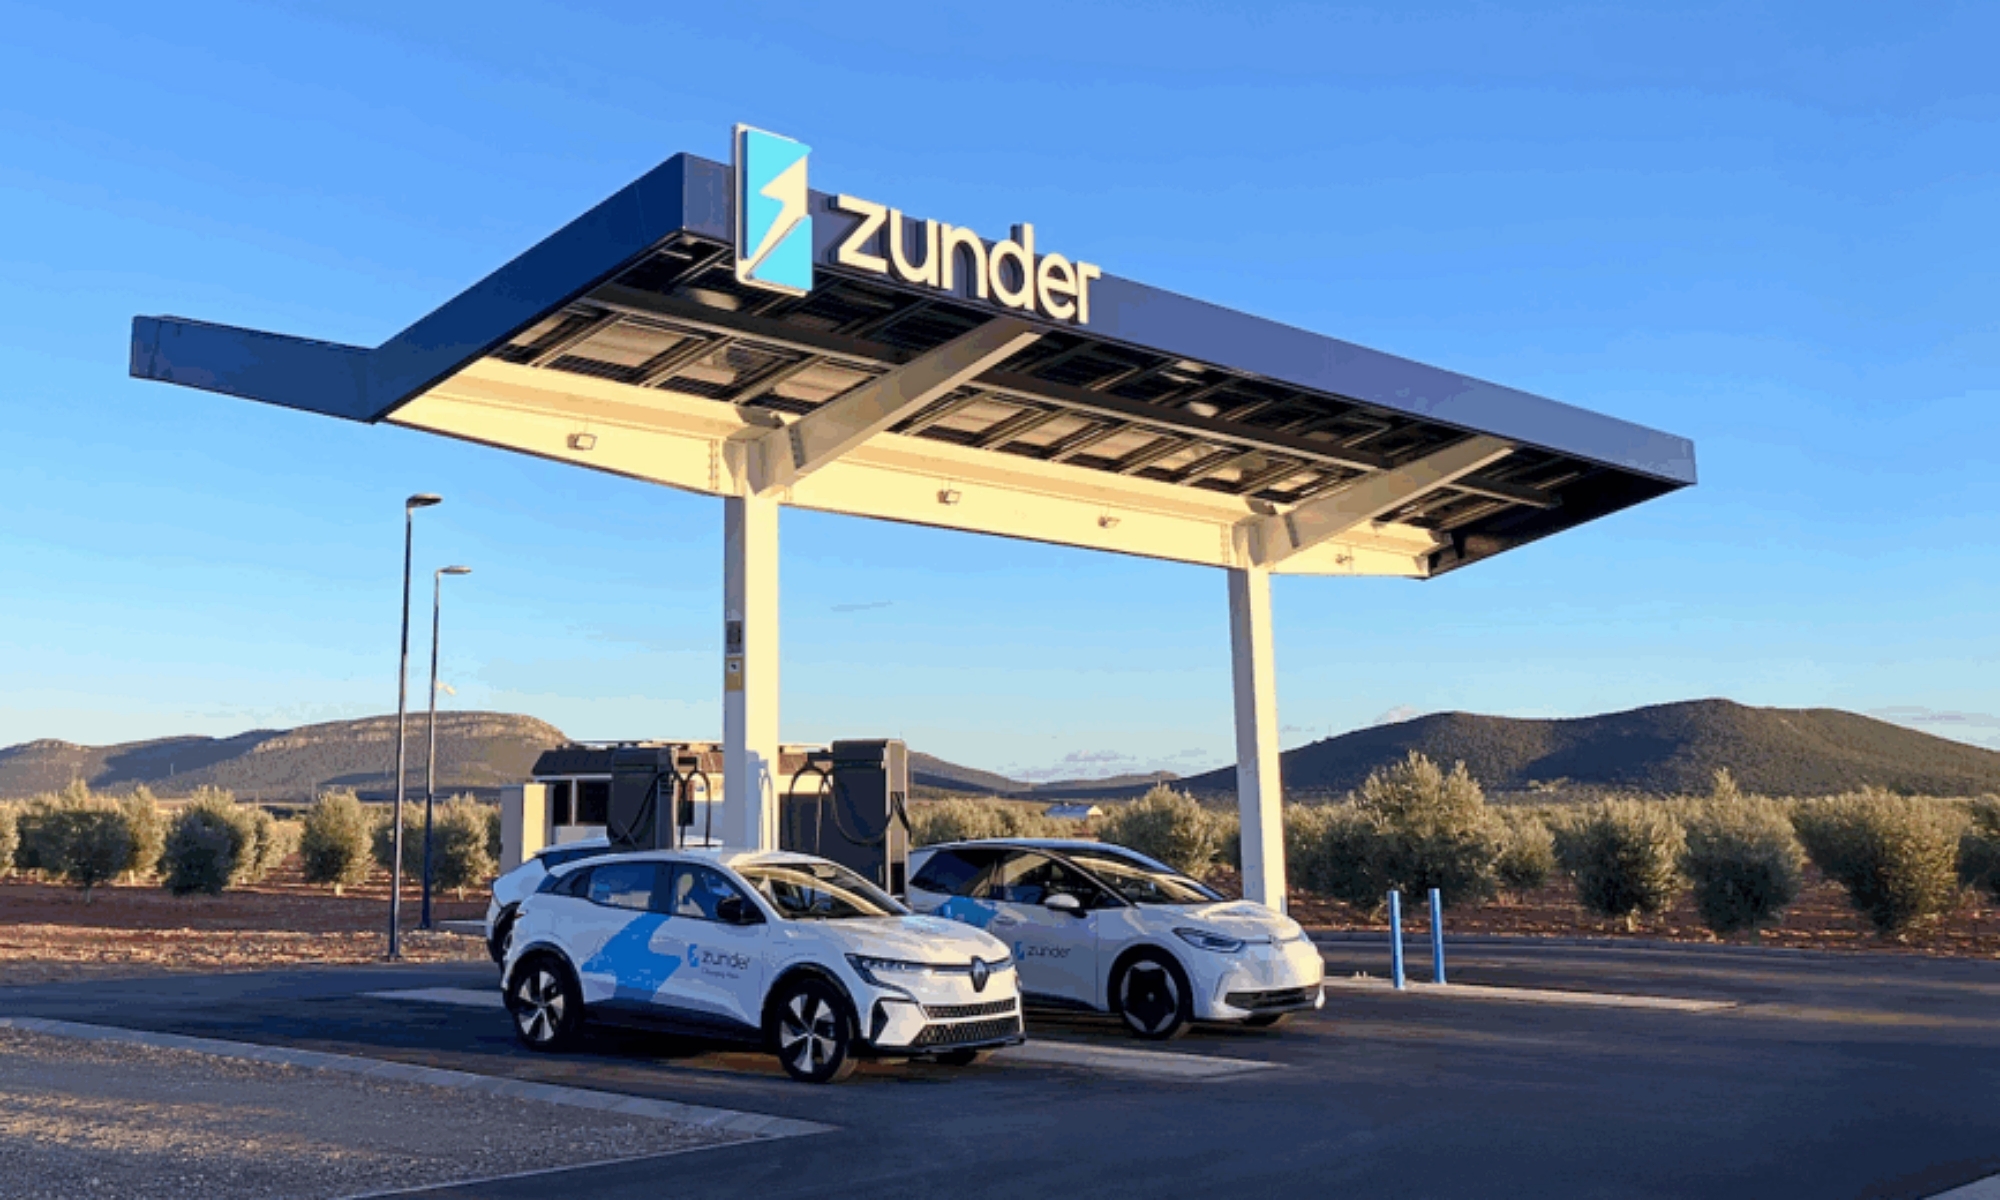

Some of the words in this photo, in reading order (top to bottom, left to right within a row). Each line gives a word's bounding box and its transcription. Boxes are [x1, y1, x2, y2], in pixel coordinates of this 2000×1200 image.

[836, 193, 1101, 324] zunder
[702, 951, 750, 970] zunder
[1027, 944, 1071, 958] zunder
